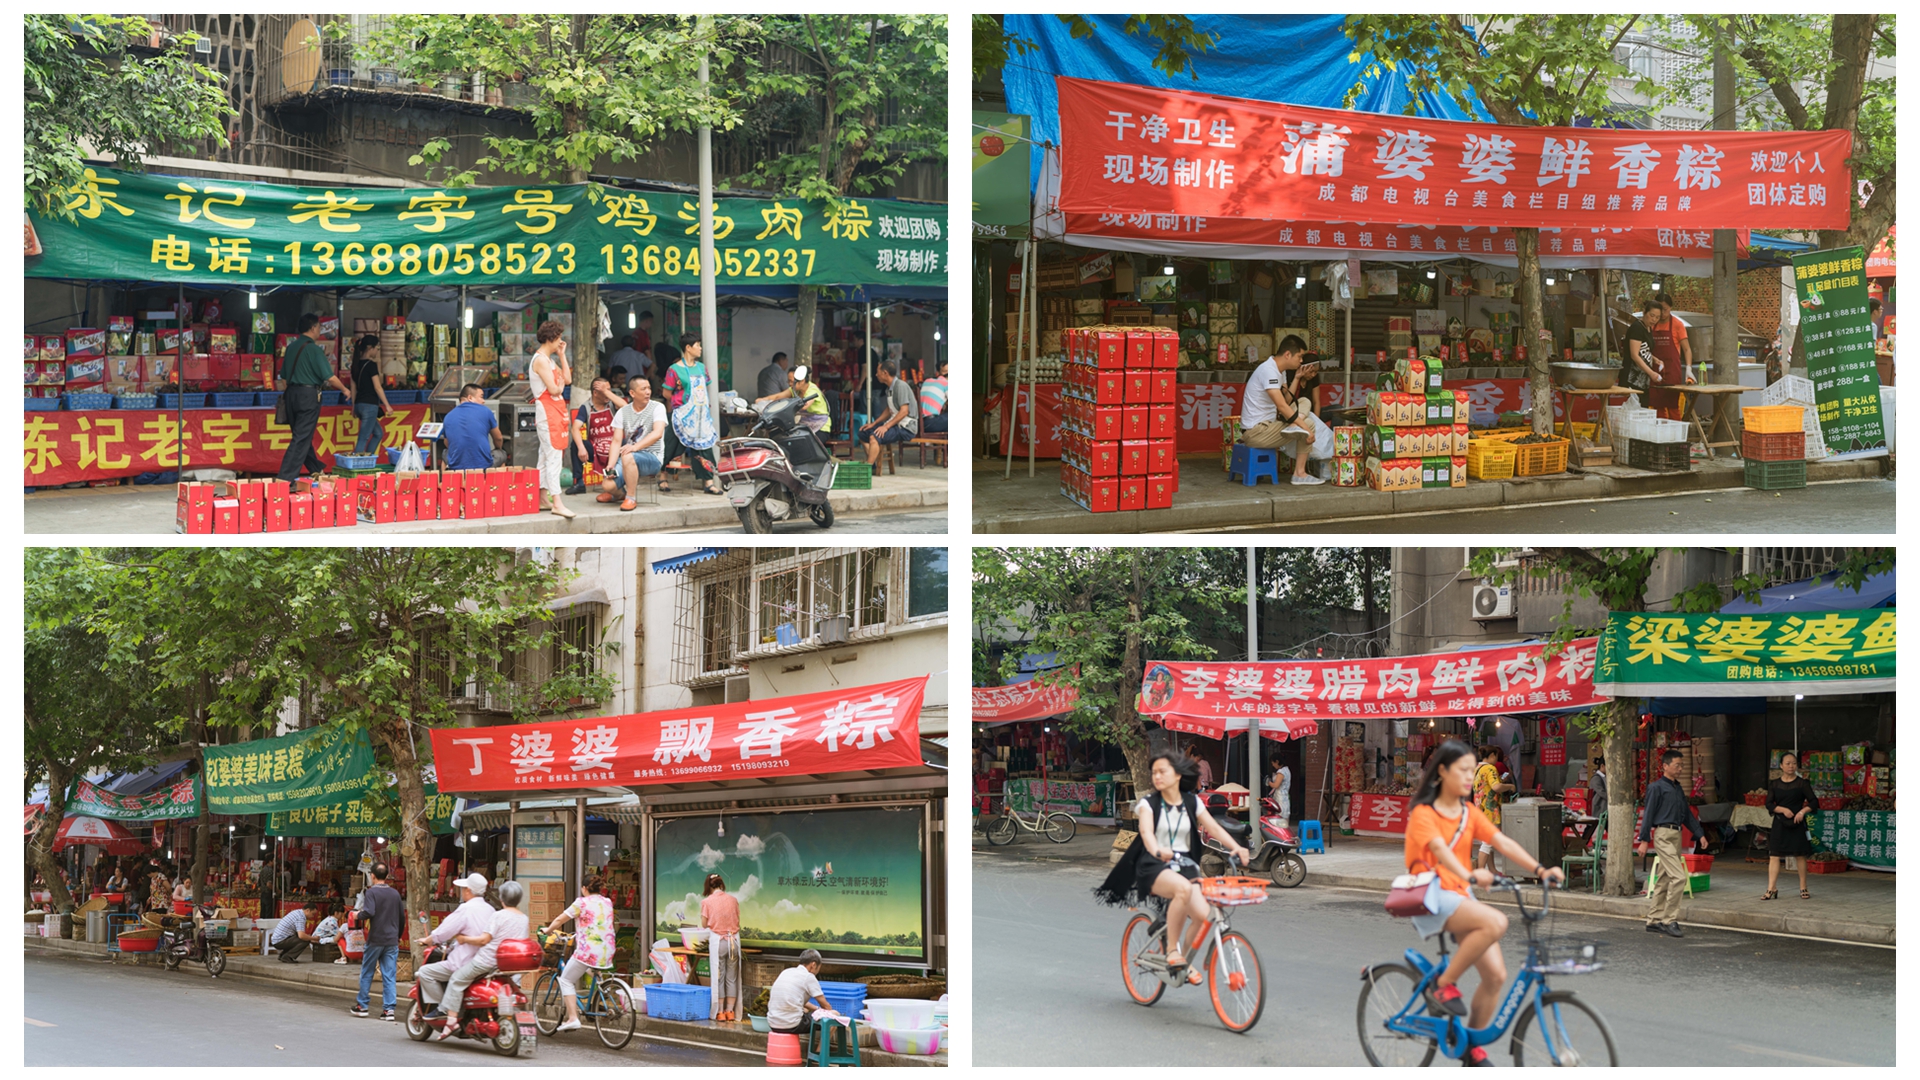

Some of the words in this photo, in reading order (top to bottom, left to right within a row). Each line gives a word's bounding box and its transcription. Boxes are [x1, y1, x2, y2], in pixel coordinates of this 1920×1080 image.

[1105, 110, 1236, 149] 干净卫生
[1281, 119, 1726, 191] 蒲婆婆鲜香粽
[1750, 150, 1826, 174] 欢迎个人
[1103, 154, 1235, 190] 现场制作
[1317, 184, 1691, 211] 成都电视台美食栏目组推荐品牌
[1747, 183, 1827, 207] 团体定购
[879, 215, 942, 241] 欢迎团购
[1278, 226, 1608, 252] 成都电视台美食栏目组荐品牌
[1657, 228, 1713, 248] 团体定
[876, 248, 939, 274] 现场制作
[1796, 258, 1863, 280] 蒲婆婆鲜香粽
[1818, 411, 1840, 422] 场制作
[1844, 405, 1878, 417] 干净卫生
[1843, 394, 1877, 407] 量大从优
[1600, 617, 1619, 677] 老字号
[1211, 702, 1318, 715] 十八年的老字号
[1327, 700, 1436, 714] 看得见的新鲜
[1447, 689, 1573, 711] 吃得到的美味
[452, 726, 619, 776] 丁婆婆
[653, 694, 899, 766] 飘香粽
[731, 759, 790, 771] 15198093219
